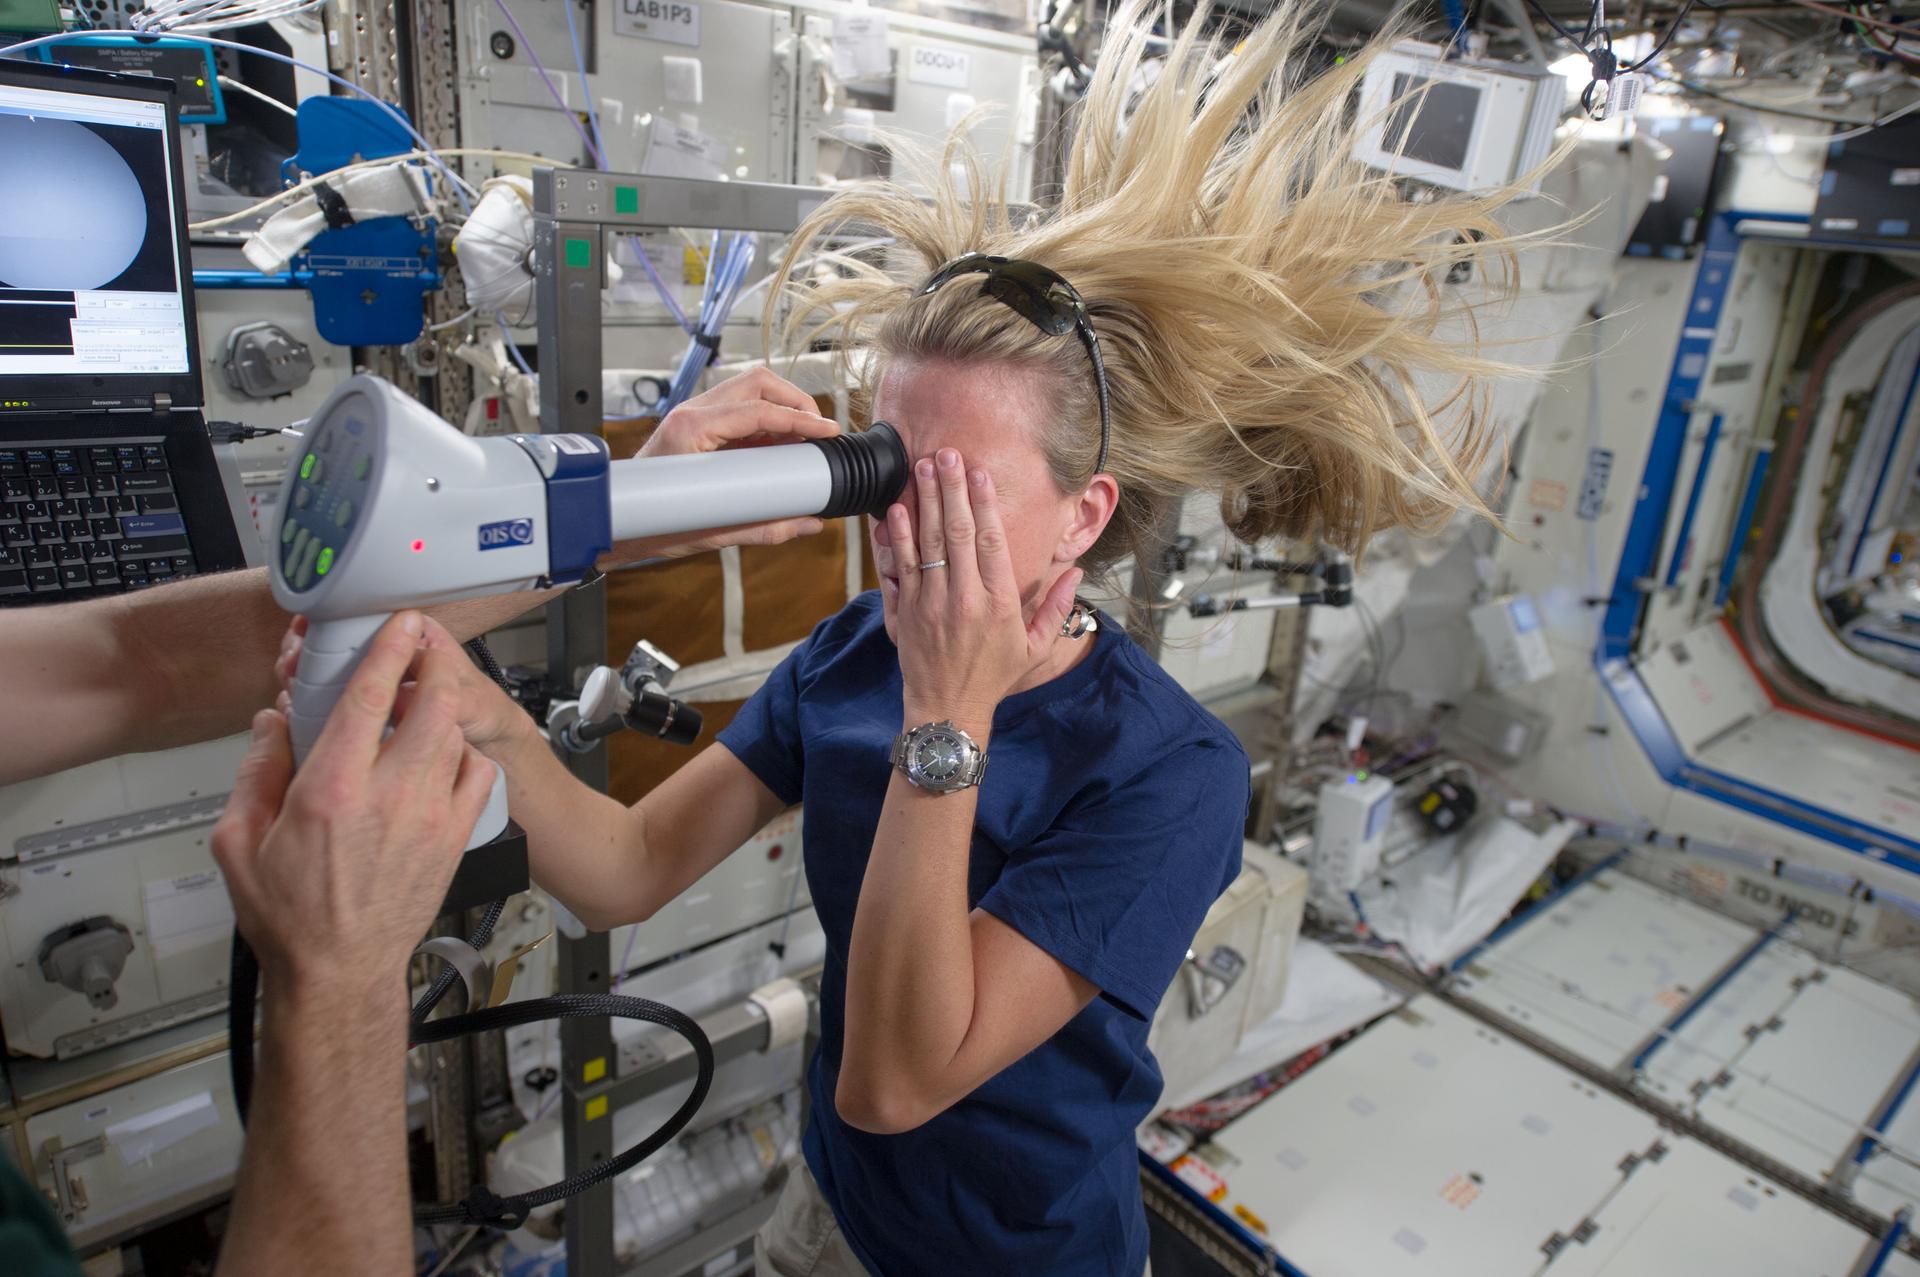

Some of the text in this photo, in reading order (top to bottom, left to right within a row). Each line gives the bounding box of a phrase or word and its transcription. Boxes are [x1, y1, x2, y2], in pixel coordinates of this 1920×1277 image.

[624, 0, 692, 25] LAB1P3
[56, 501, 64, 509] P
[8, 526, 17, 535] K
[39, 524, 48, 533] L
[480, 526, 509, 546] OIS
[1739, 878, 1771, 904] TO
[1776, 895, 1835, 928] NOD
